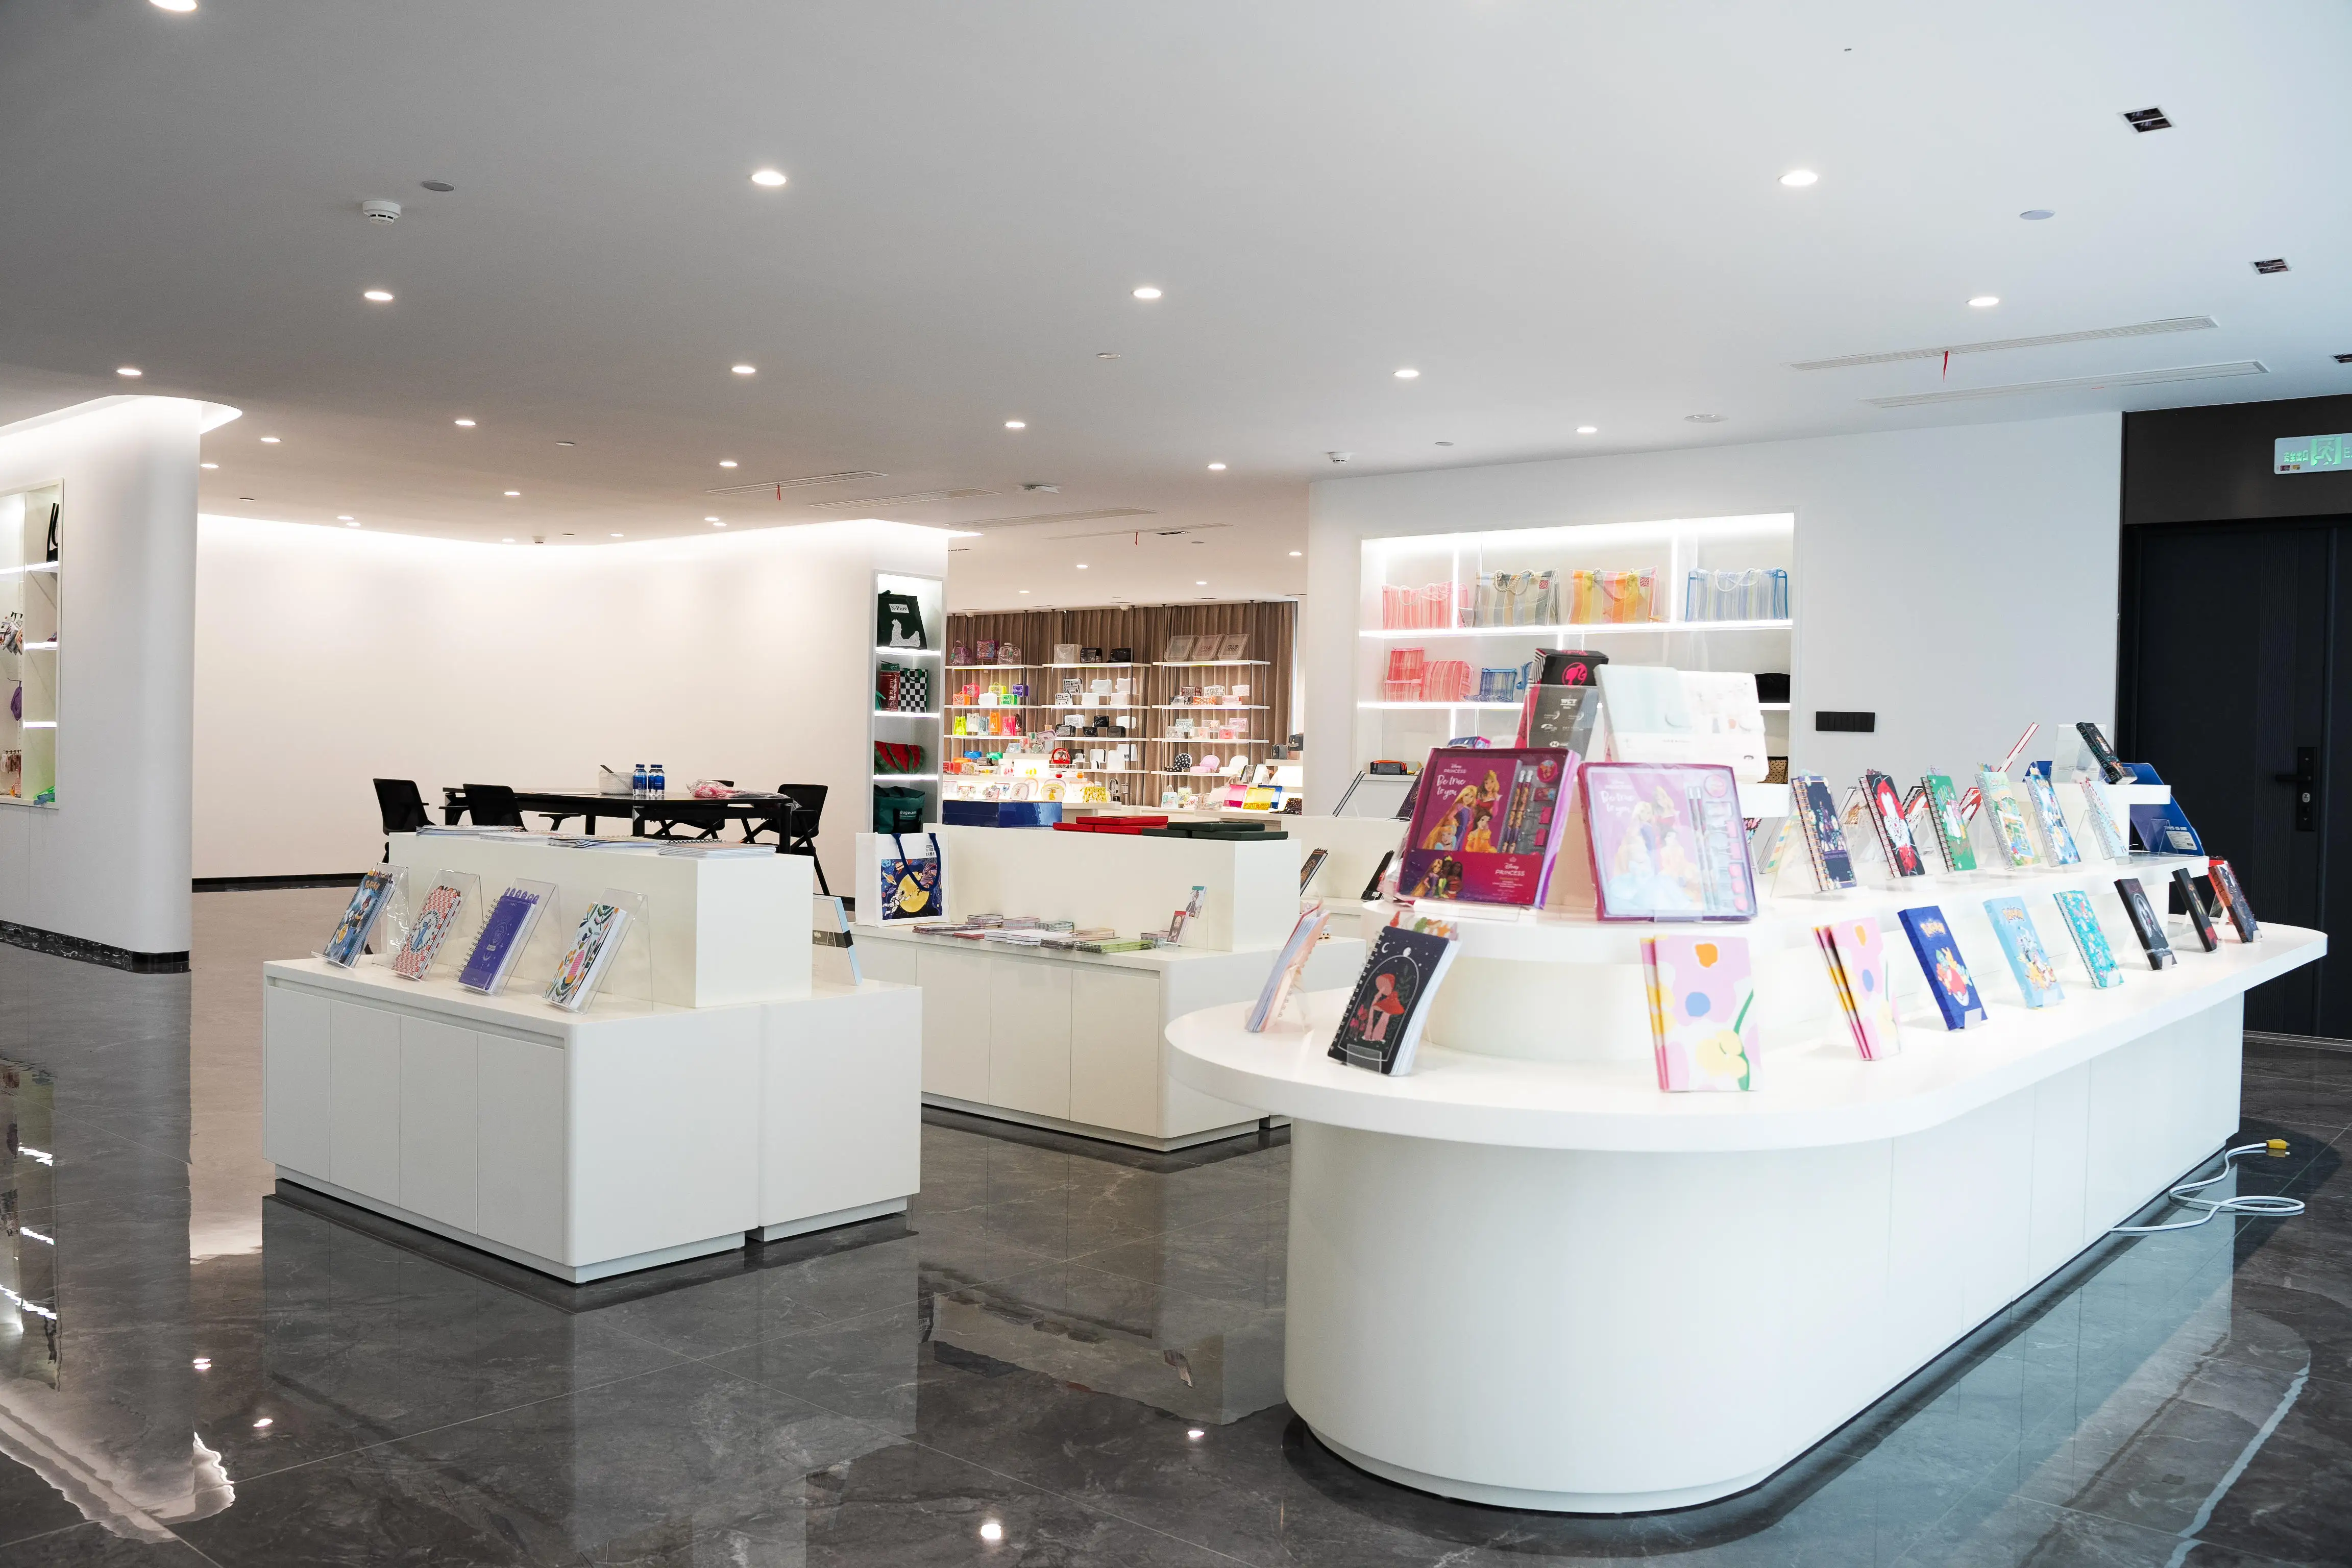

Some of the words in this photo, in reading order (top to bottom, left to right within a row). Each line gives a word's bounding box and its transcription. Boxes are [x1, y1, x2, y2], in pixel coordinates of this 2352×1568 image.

[2284, 450, 2308, 462] 安全出口
[1436, 774, 1449, 786] Be
[1449, 775, 1466, 786] true
